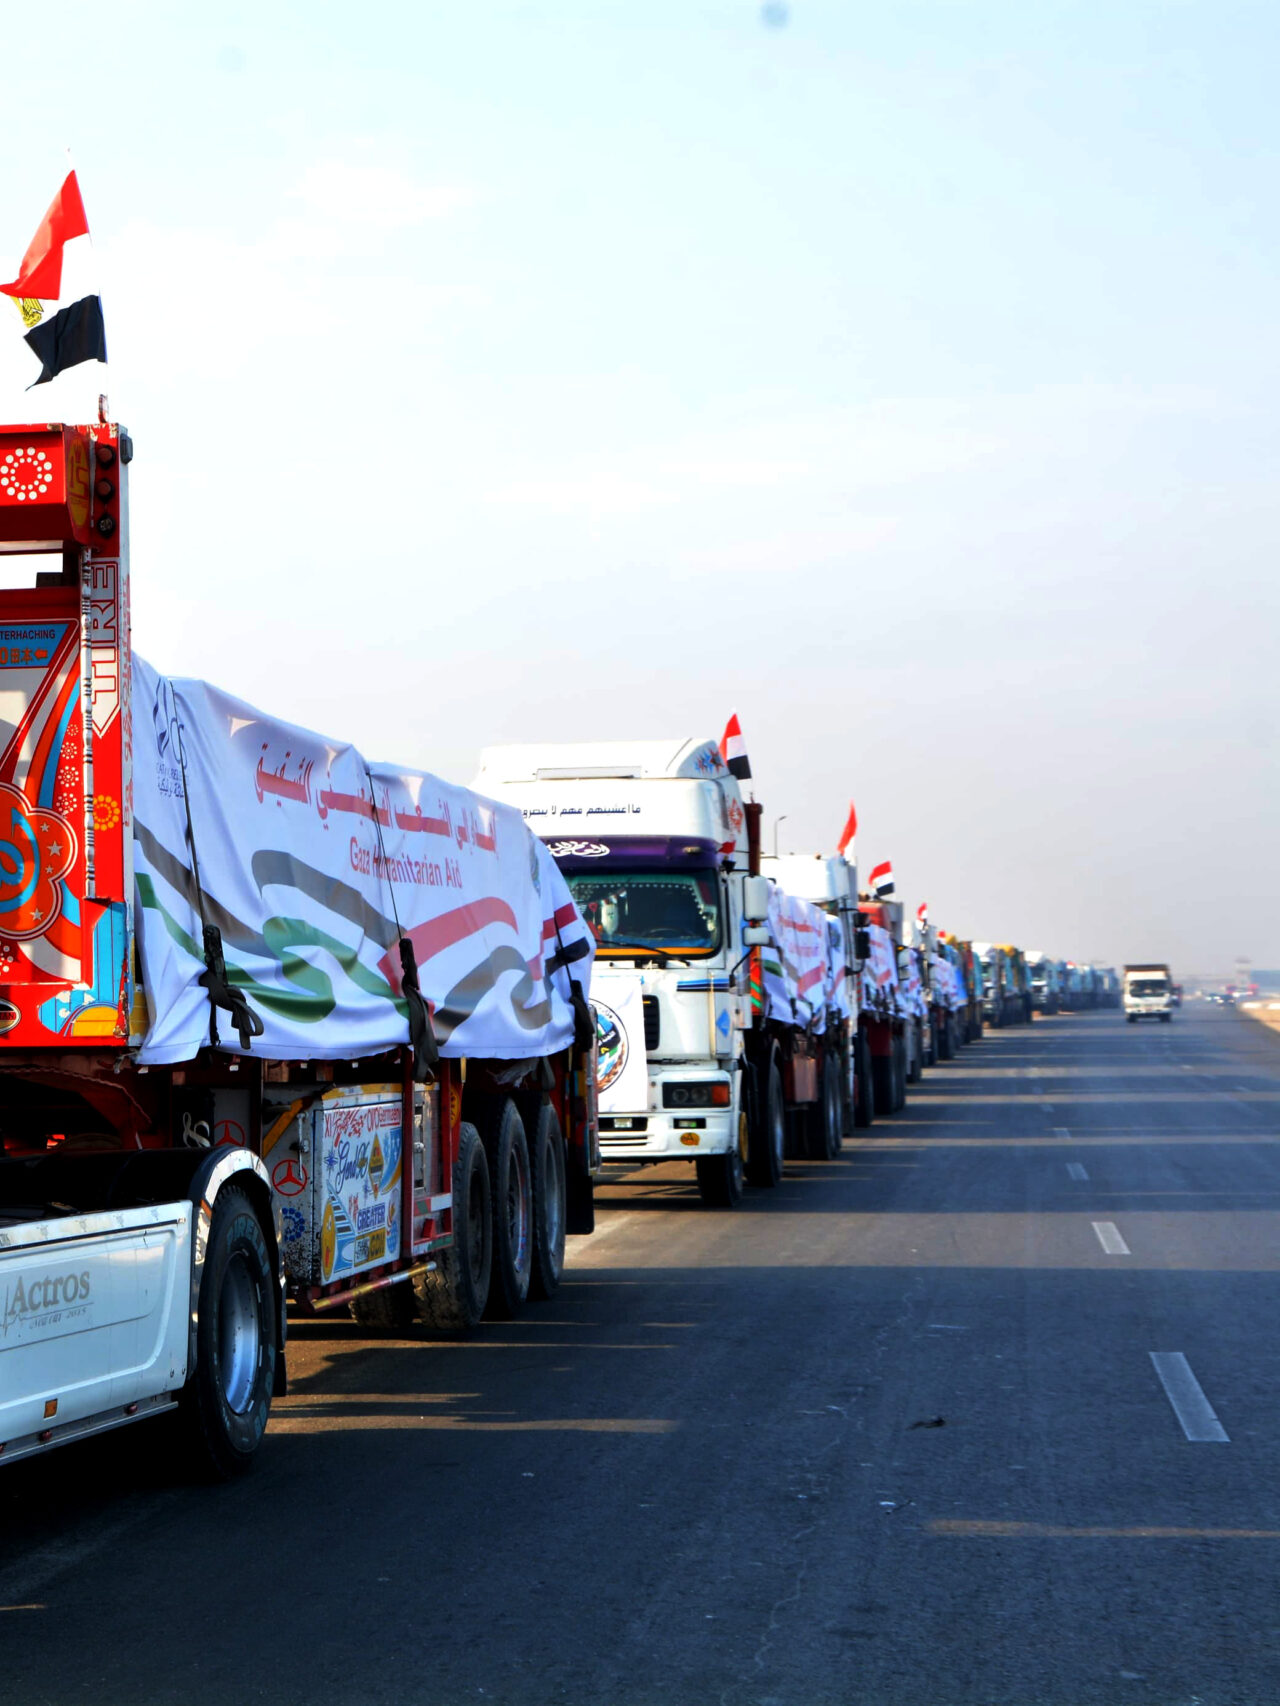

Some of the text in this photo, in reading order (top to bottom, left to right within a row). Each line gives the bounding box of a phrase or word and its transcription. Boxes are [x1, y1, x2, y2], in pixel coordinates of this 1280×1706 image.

[349, 836, 463, 889] Gaza Humanitarian Aid
[7, 1271, 90, 1316] Actros
